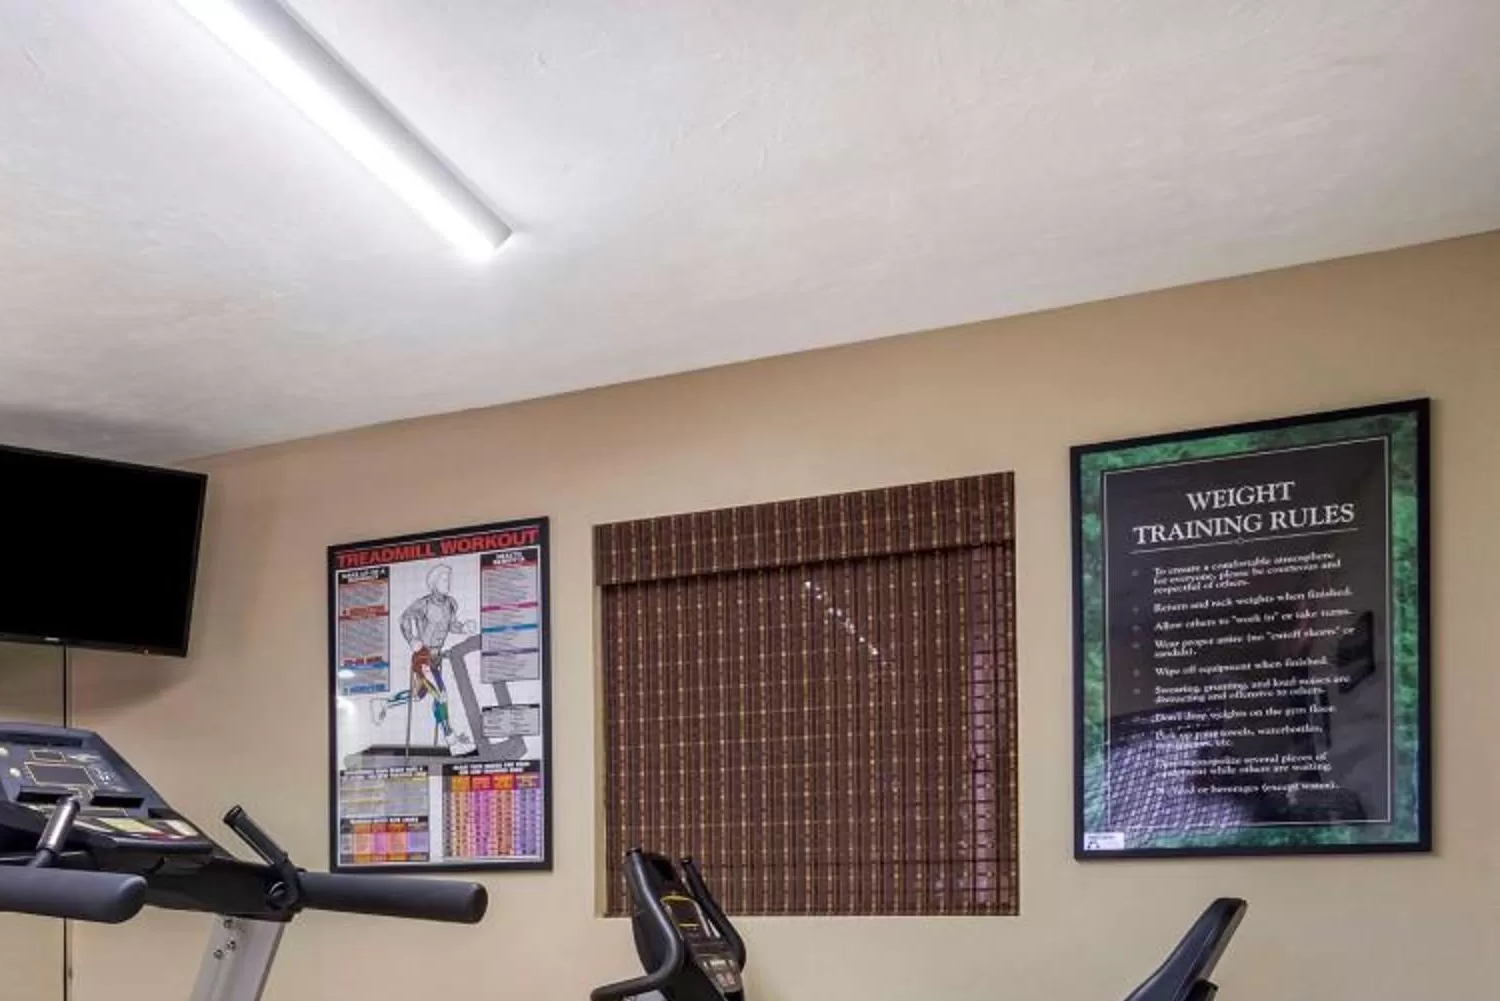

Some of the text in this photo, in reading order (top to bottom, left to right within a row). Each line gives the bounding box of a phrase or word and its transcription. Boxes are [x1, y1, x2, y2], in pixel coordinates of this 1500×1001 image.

[1186, 480, 1295, 512] WEIGHT
[1132, 503, 1356, 545] TRAINING RULES
[336, 530, 540, 570] TREADMILL WORKOUT
[1211, 557, 1271, 571] comfortable
[1273, 552, 1335, 566] atmosphere
[1321, 558, 1341, 569] and
[1190, 599, 1209, 609] and
[1276, 591, 1305, 601] when
[1155, 667, 1181, 678] Wipe
[1253, 659, 1282, 670] when
